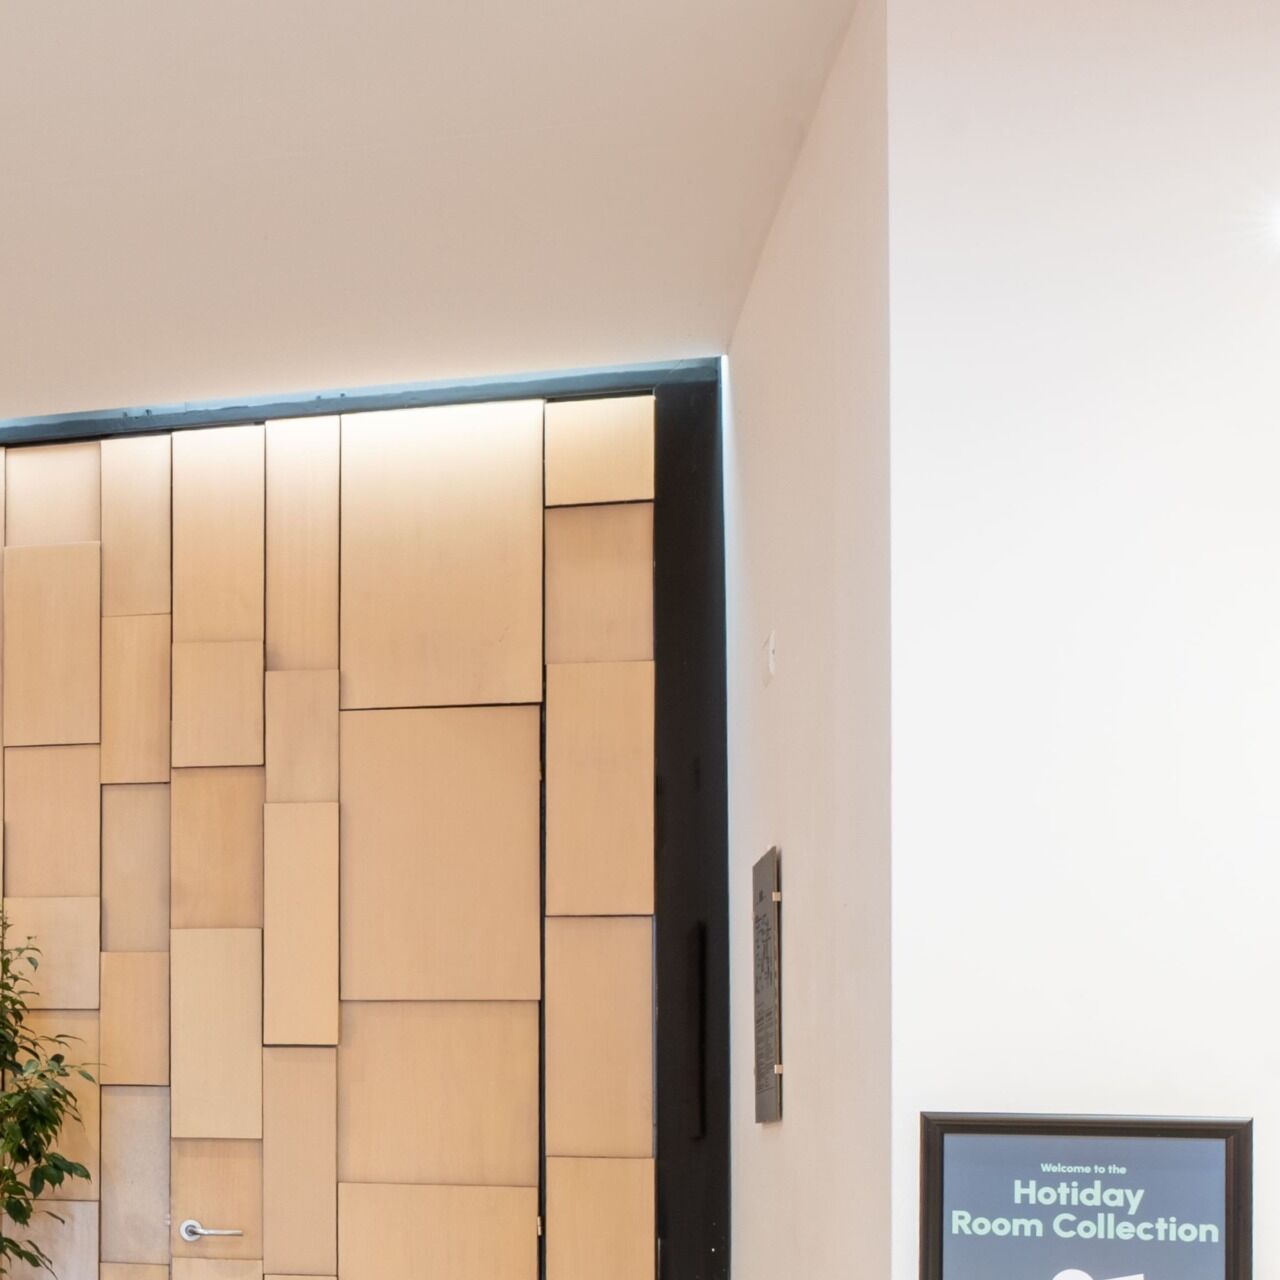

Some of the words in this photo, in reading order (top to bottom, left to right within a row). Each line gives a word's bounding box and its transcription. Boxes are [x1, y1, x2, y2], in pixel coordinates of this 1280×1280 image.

[1040, 1162, 1092, 1175] Welcome
[1093, 1164, 1106, 1175] to
[1107, 1164, 1128, 1175] the
[1013, 1179, 1145, 1216] Hotiday
[951, 1209, 1044, 1238] Room
[1052, 1212, 1220, 1243] Collection
